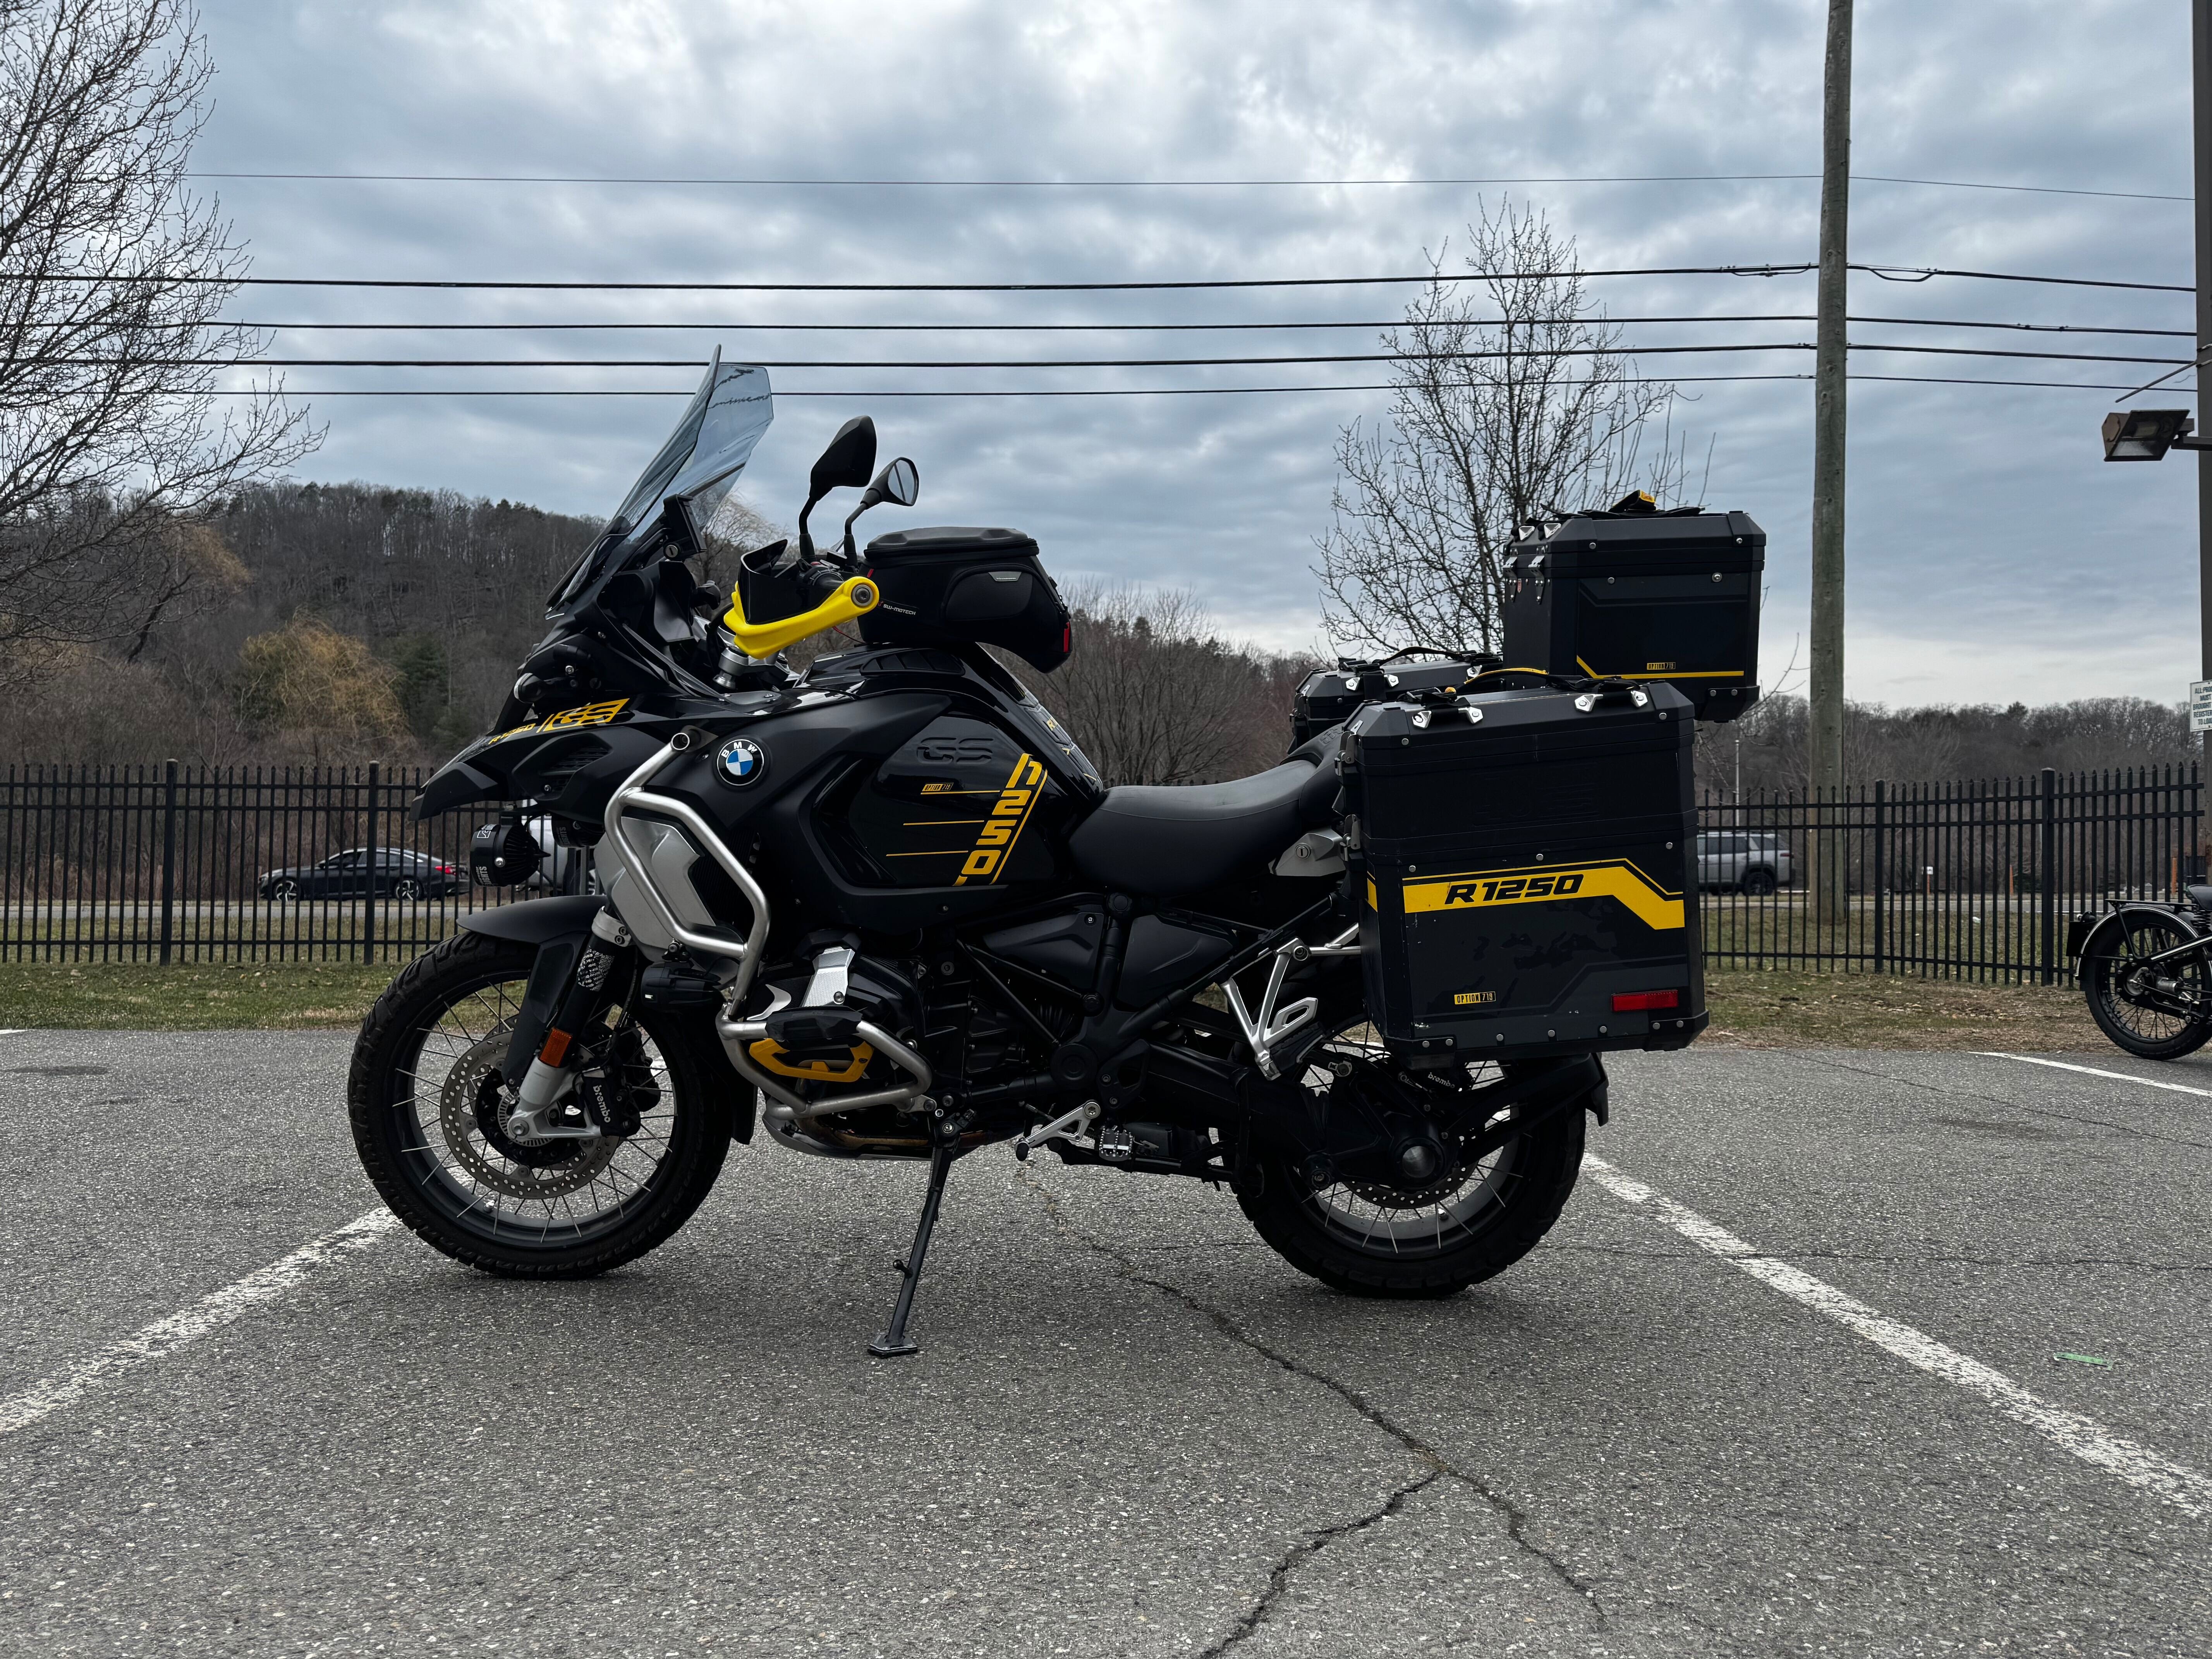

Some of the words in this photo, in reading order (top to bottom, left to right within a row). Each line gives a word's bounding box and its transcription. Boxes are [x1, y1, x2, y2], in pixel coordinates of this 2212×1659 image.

[883, 604, 916, 615] SW-MOTECH
[721, 741, 757, 758] BMW
[916, 737, 994, 764] GS
[479, 866, 491, 884] LIGHTS
[1457, 994, 1479, 1003] OPTION
[1482, 993, 1492, 1001] 719
[1427, 1072, 1455, 1089] brembo
[593, 1085, 611, 1123] brembo
